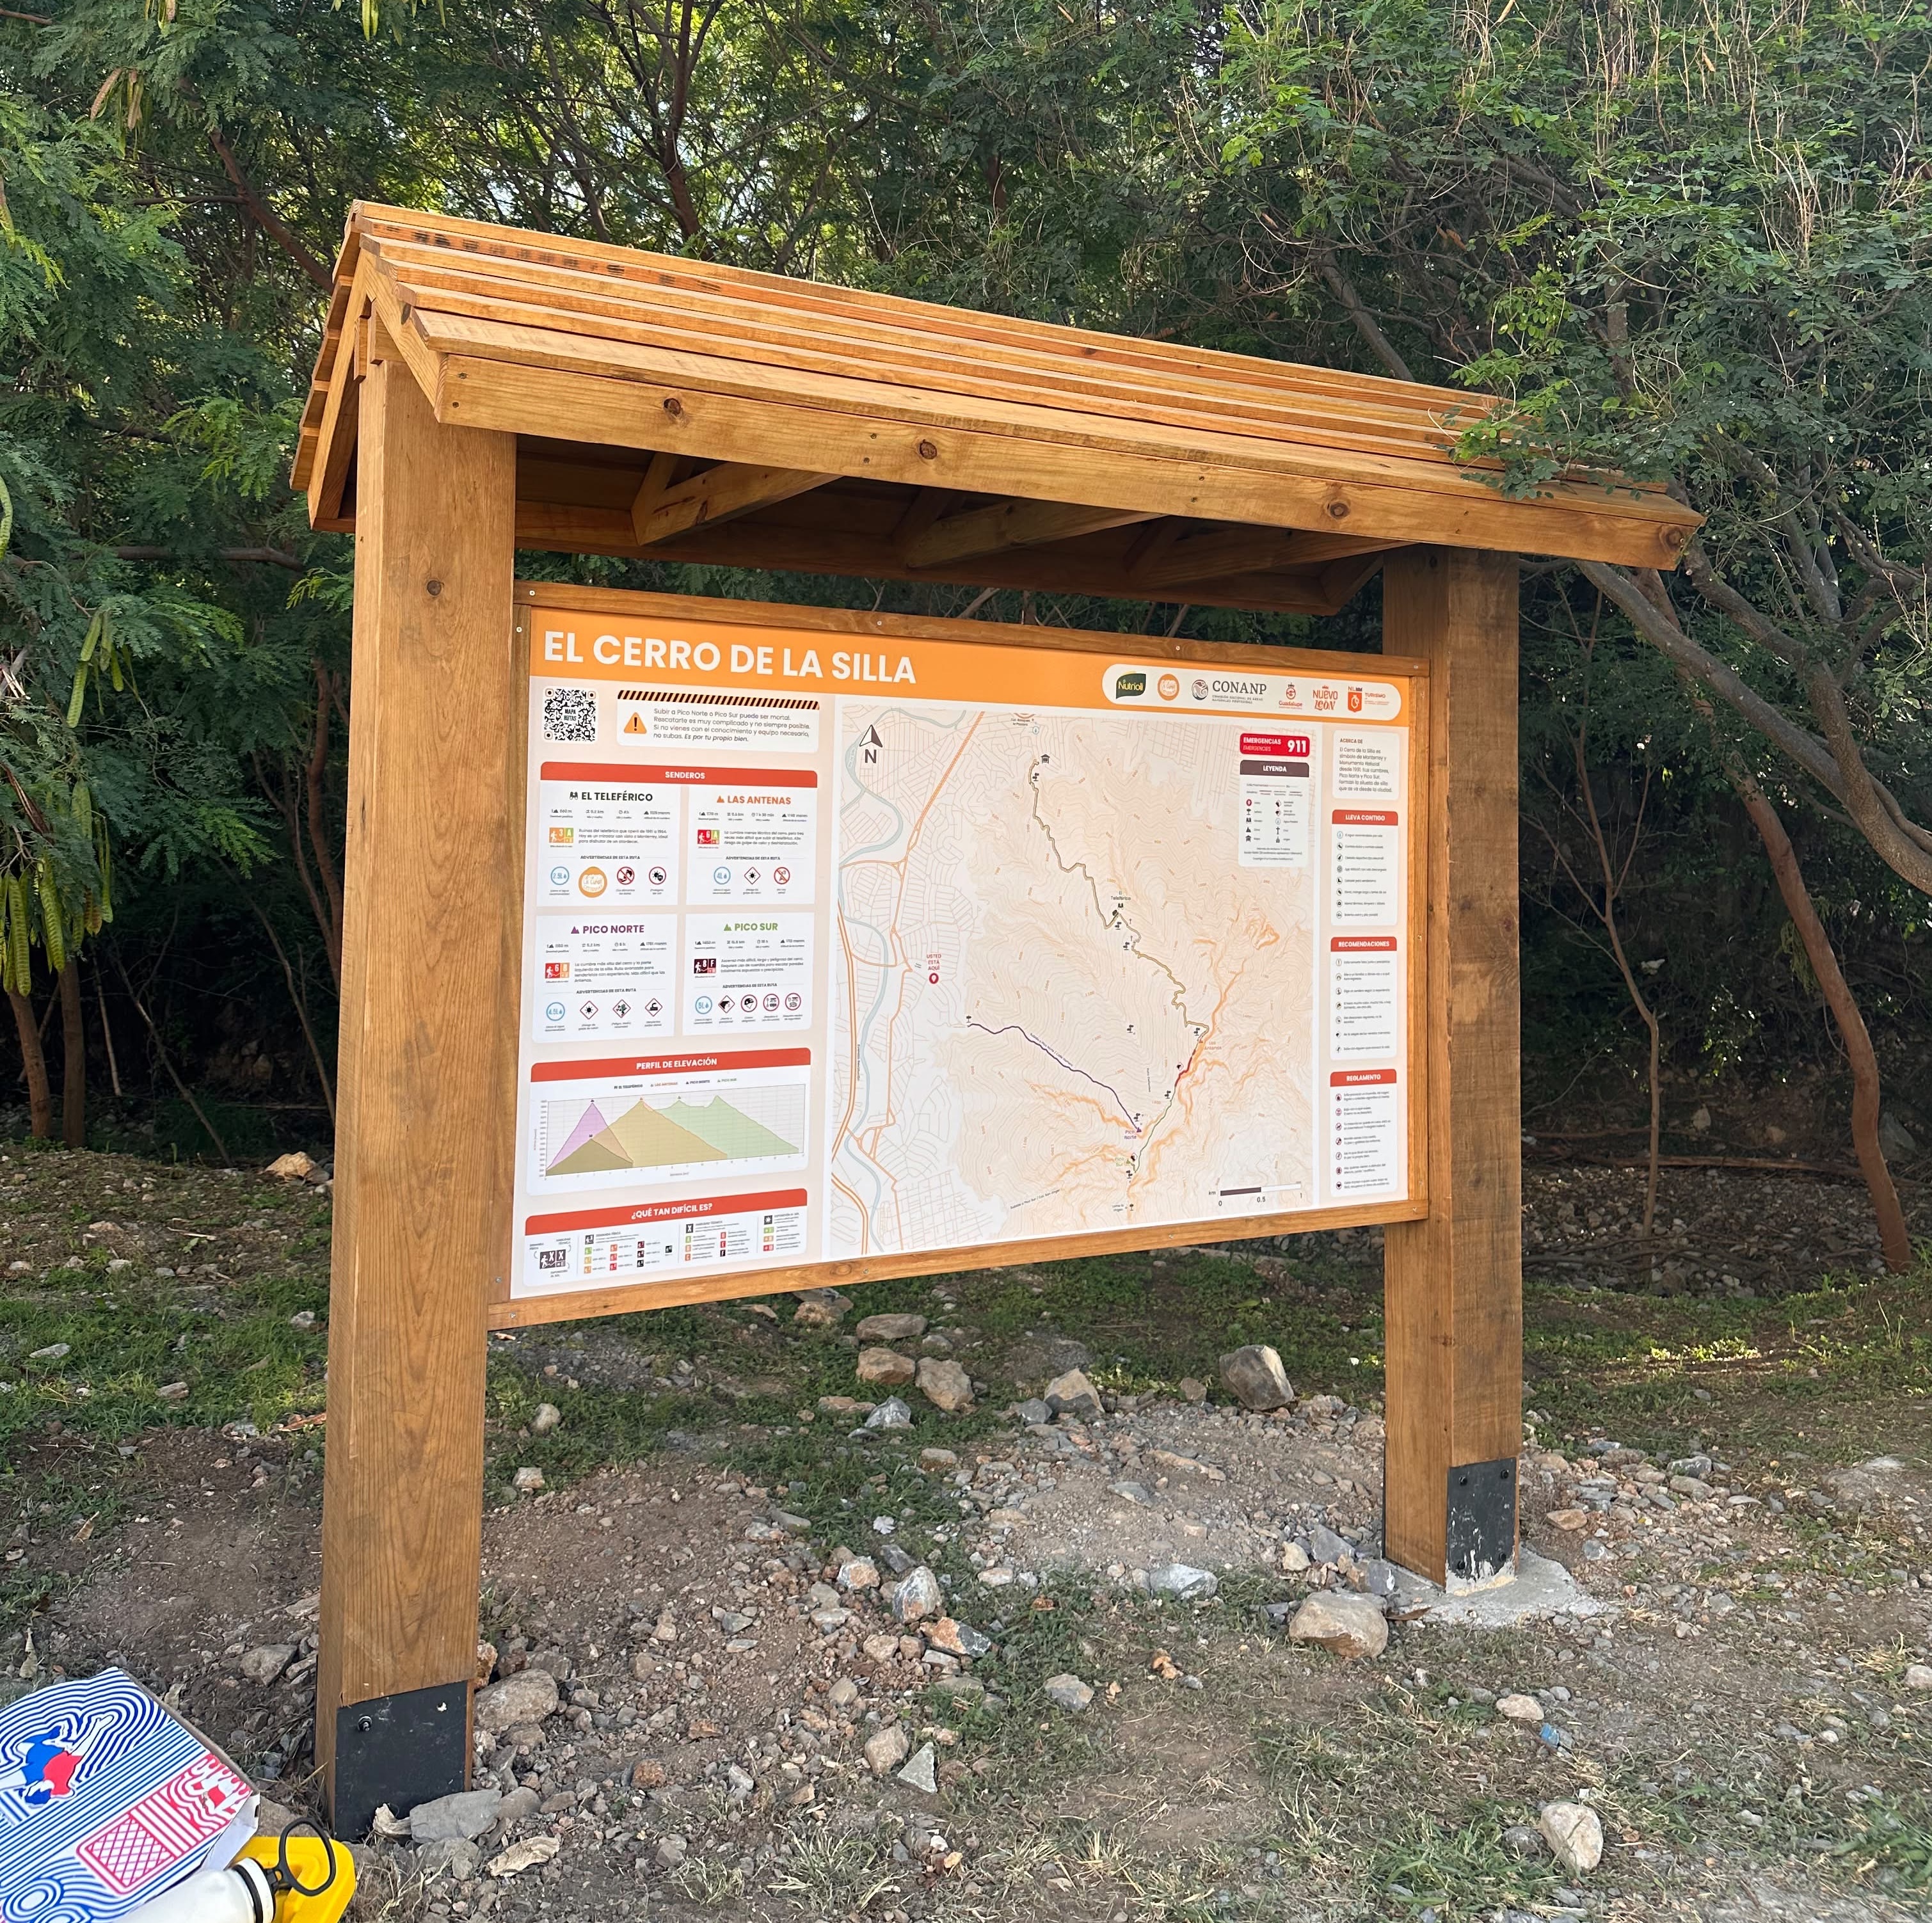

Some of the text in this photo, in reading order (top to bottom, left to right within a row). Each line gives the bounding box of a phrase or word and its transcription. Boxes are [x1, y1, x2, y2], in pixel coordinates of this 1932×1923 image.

[544, 630, 916, 684] EL CERRO DE LA SILLA
[1119, 682, 1143, 690] Nutrioli
[1213, 680, 1266, 694] CONANP
[1288, 740, 1306, 753] 911
[865, 749, 877, 763] N
[666, 771, 705, 779] SENDEROS
[595, 790, 653, 801] TELEFÉRICO
[747, 797, 791, 805] ANTENAS
[611, 925, 644, 933] NORTE
[674, 1057, 717, 1067] ELEVACIÓN
[631, 1208, 652, 1220] ¿QUÉ
[653, 1208, 669, 1216] TAN
[671, 1204, 698, 1214] DIFÍCIL
